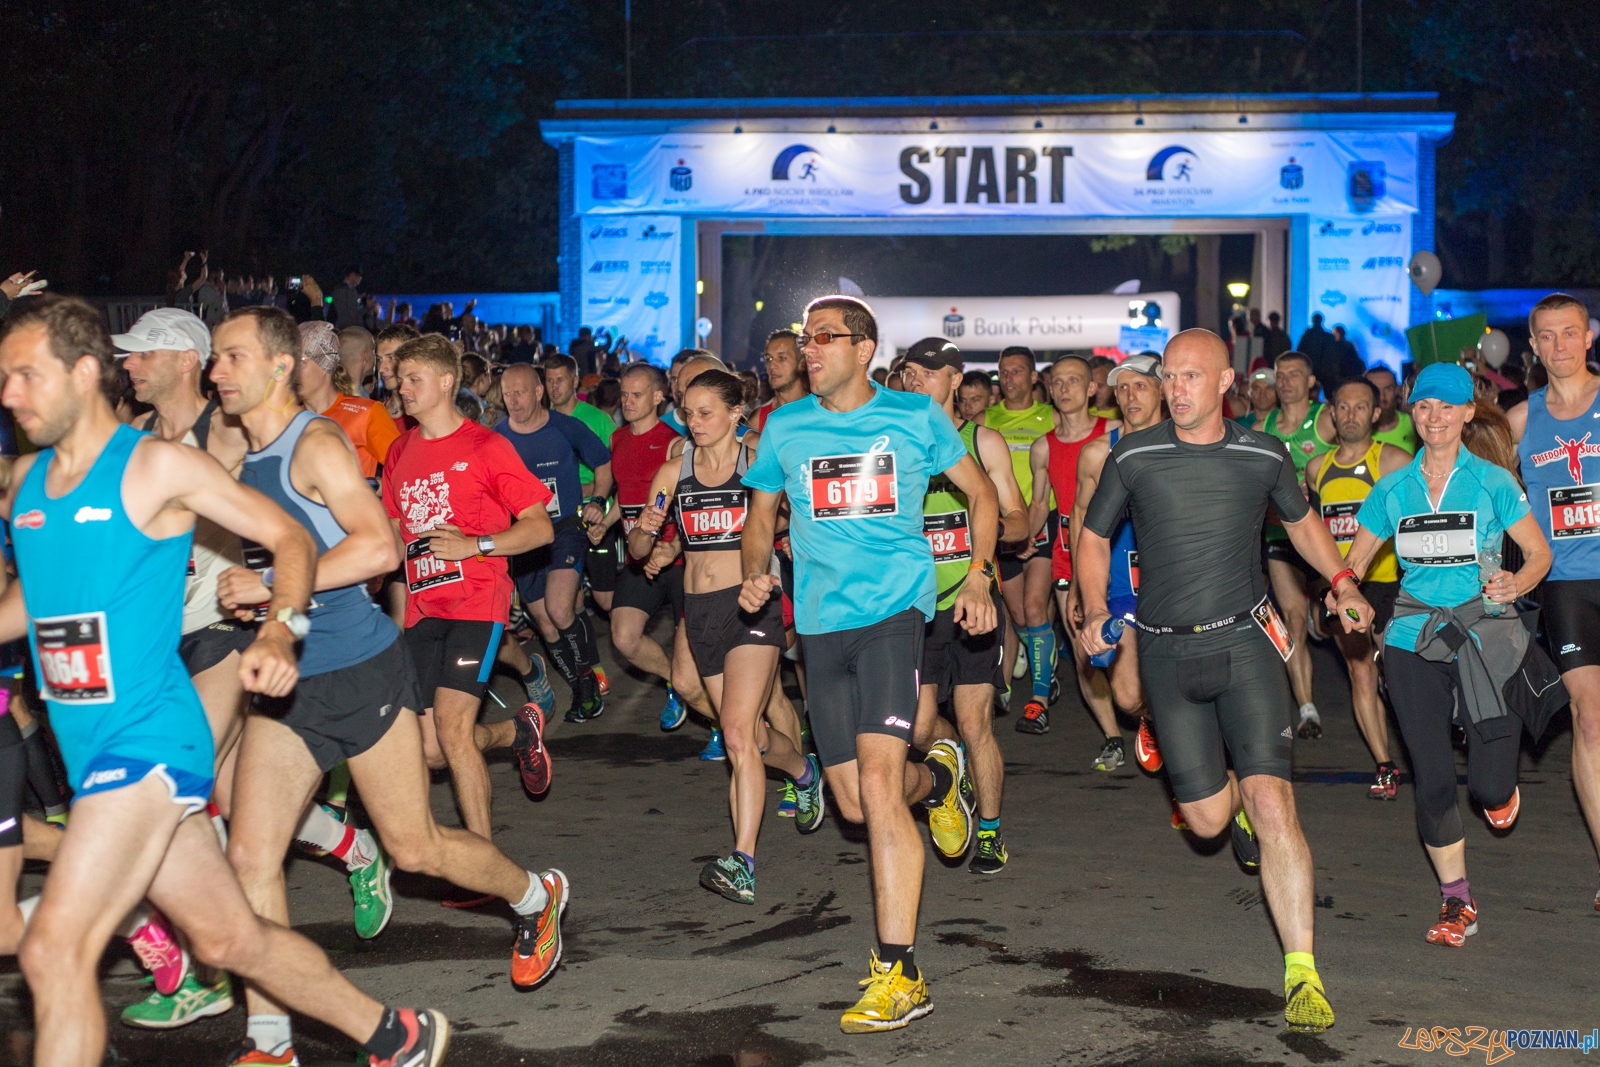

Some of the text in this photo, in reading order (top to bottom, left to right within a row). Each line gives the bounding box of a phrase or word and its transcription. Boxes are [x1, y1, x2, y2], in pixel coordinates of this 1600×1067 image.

[899, 145, 1073, 205] START
[974, 317, 1021, 336] Bank
[1029, 316, 1083, 336] Polski
[827, 478, 879, 505] 6179
[690, 510, 733, 533] 7840
[1329, 517, 1360, 535] 6229
[1563, 503, 1600, 527] 8413
[1421, 532, 1449, 555] 39
[414, 554, 446, 579] 7914
[1202, 616, 1235, 631] ICEBUG
